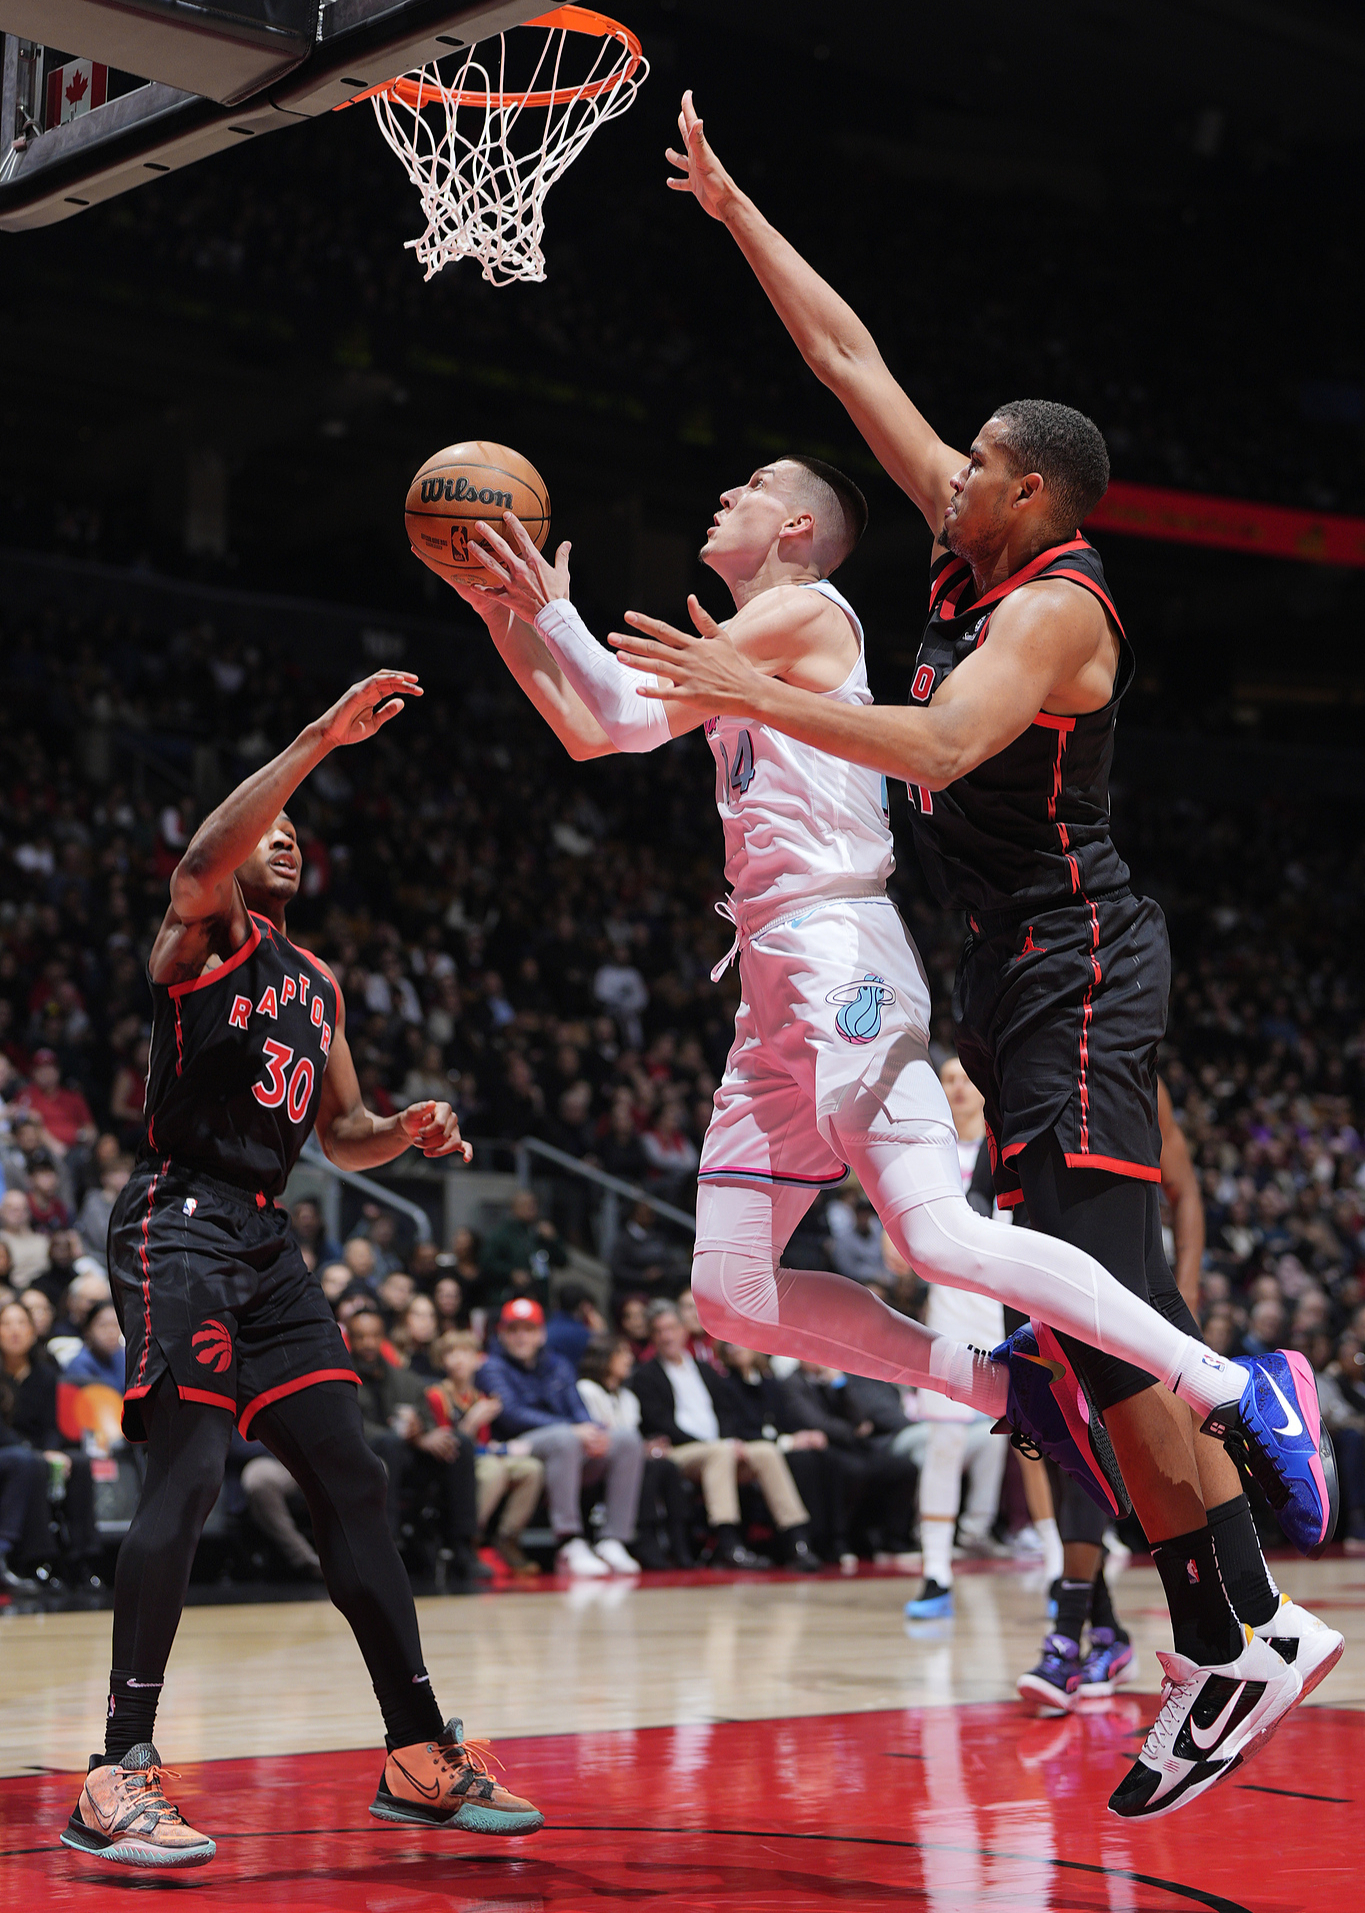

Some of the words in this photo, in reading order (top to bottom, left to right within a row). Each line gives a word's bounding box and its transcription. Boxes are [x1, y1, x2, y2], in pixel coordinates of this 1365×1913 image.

[421, 477, 513, 510] Wilson
[719, 729, 755, 806] 14
[228, 973, 331, 1071] RAPTOR
[251, 1037, 314, 1124] 30
